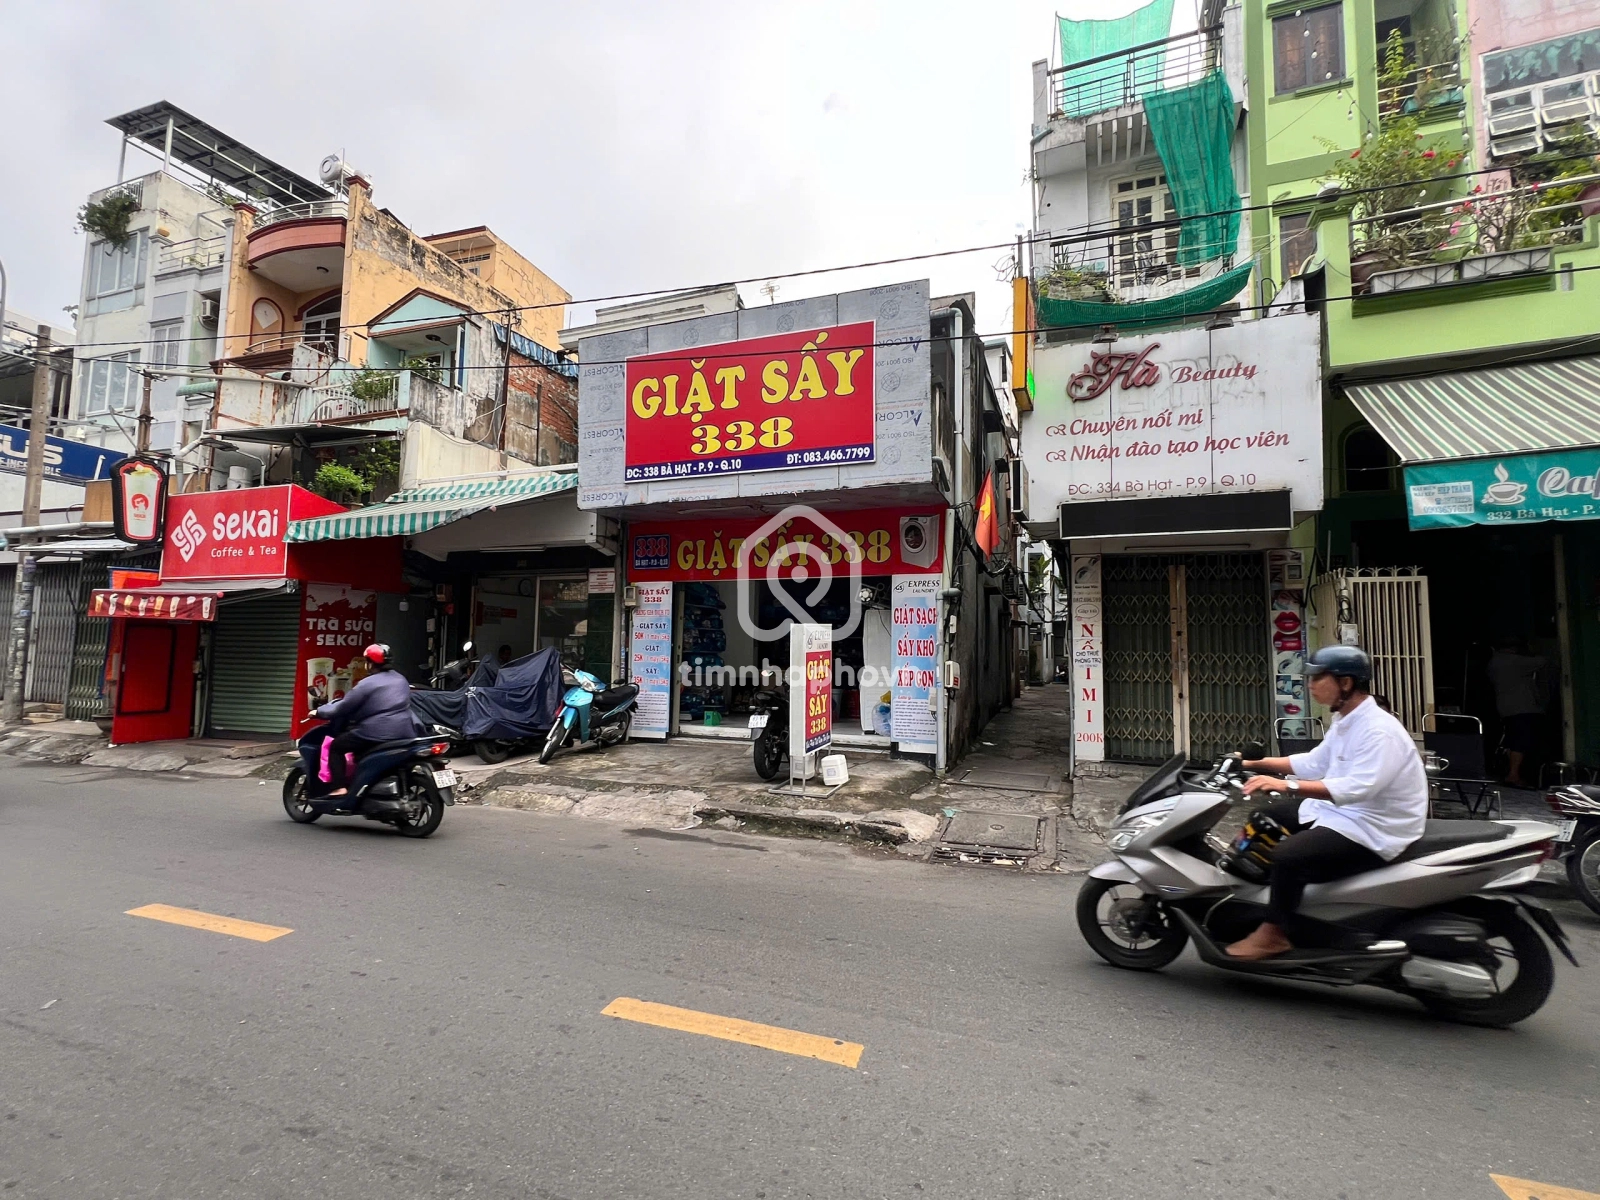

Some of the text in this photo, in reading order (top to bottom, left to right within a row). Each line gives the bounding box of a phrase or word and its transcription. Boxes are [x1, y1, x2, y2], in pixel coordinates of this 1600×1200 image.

[632, 331, 864, 423] GIẶT SẤY
[1067, 342, 1259, 403] Hà Beauty
[690, 416, 794, 455] 338
[1070, 409, 1203, 436] Chuyên nối mi
[0, 434, 63, 465] US
[787, 447, 870, 464] ĐT: 083.466.7799
[1070, 430, 1290, 462] Nhận đào tạo học viên
[627, 467, 642, 478] ĐC:
[644, 466, 659, 477] 338
[661, 462, 672, 475] BÀ
[675, 463, 692, 476] HẠT
[720, 459, 741, 470] Q.10
[1068, 484, 1092, 495] ĐC:
[1097, 482, 1120, 494] 334
[1126, 480, 1143, 492] Bà
[1148, 479, 1173, 493] Hạt
[1186, 477, 1207, 488] P.9
[1221, 473, 1256, 486] Q.10
[1487, 510, 1512, 520] 332
[1517, 508, 1536, 519] Bà
[1541, 507, 1569, 519] Hạt
[211, 545, 277, 558] Coffee & Tea
[636, 519, 891, 576] 338 GIẶT SẤY 338
[656, 586, 670, 595] SẤY
[894, 604, 914, 628] GIẶT
[898, 632, 934, 657] SẤY KHÔ
[807, 655, 830, 683] GIẶT
[898, 662, 914, 687] XẾP
[916, 670, 934, 691] GỌN
[809, 686, 828, 717] SẤY
[810, 717, 827, 734] 338
[1076, 733, 1104, 743] 200K
